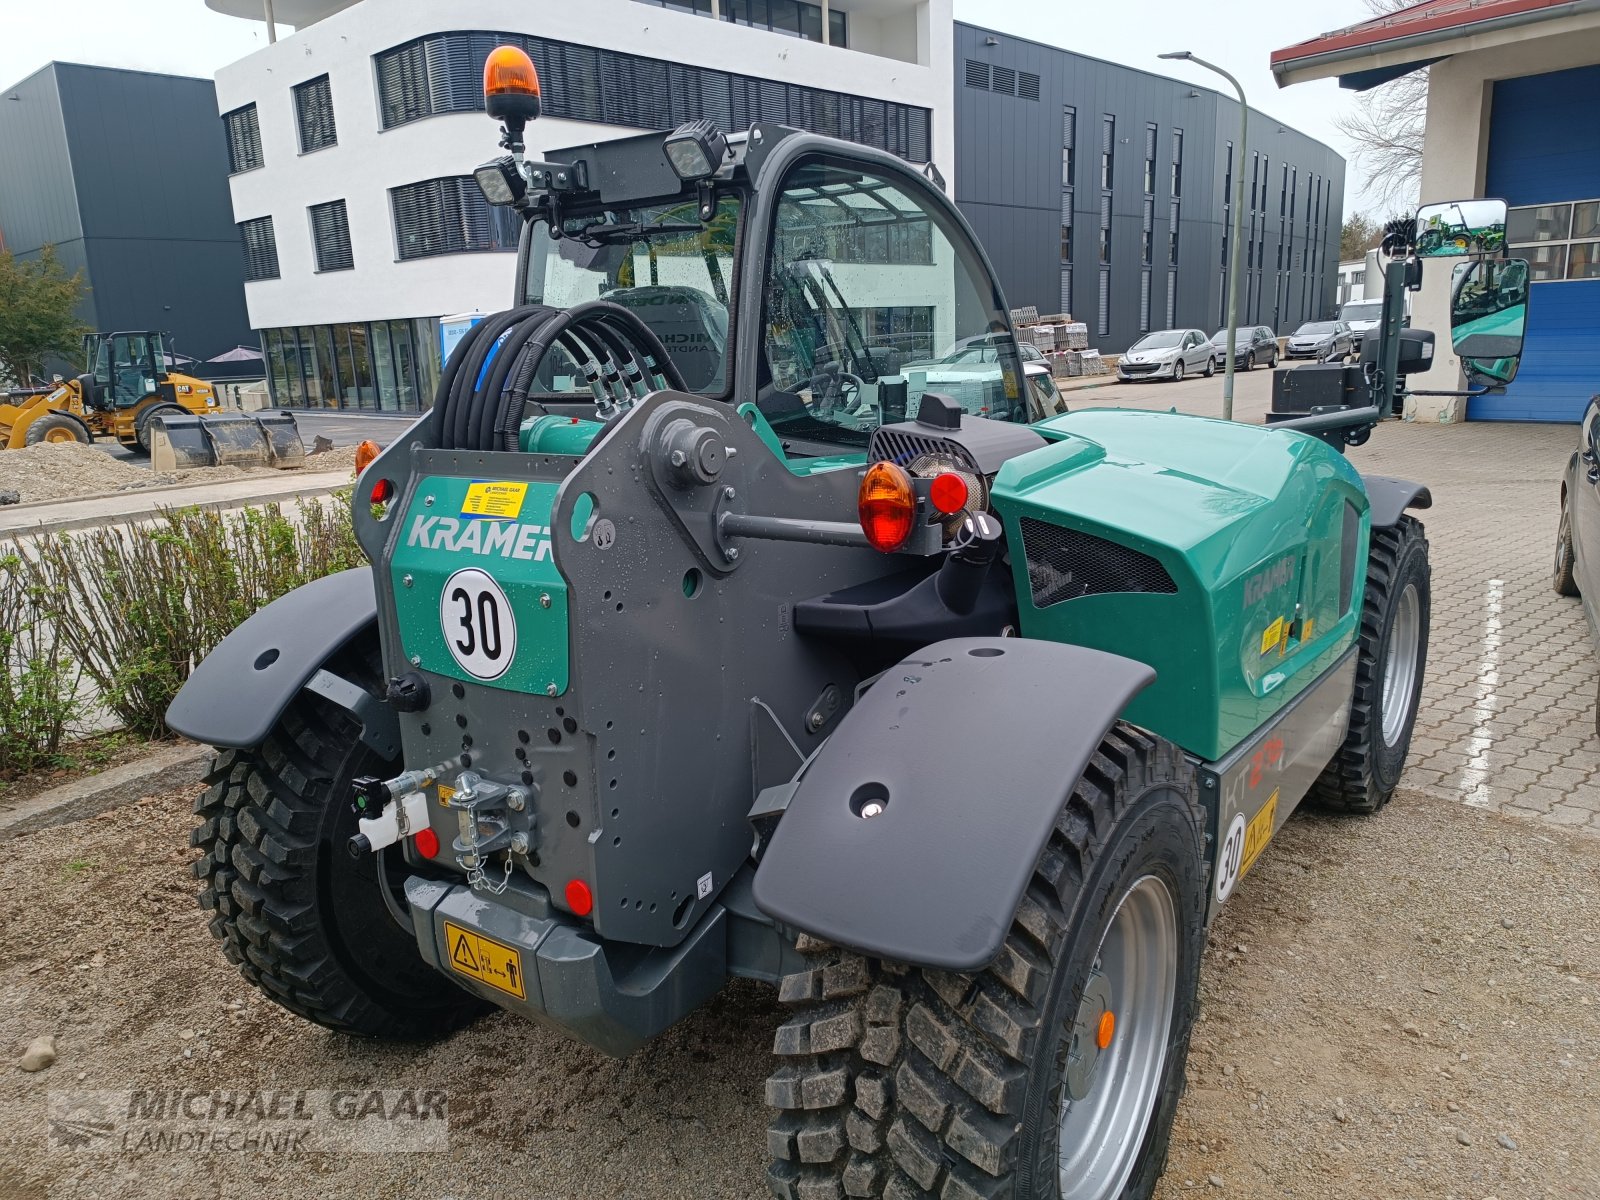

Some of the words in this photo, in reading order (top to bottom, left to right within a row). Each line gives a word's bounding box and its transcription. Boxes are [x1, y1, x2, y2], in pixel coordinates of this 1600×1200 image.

[177, 385, 190, 393] CAT
[451, 587, 502, 661] 30
[1220, 826, 1242, 891] 30
